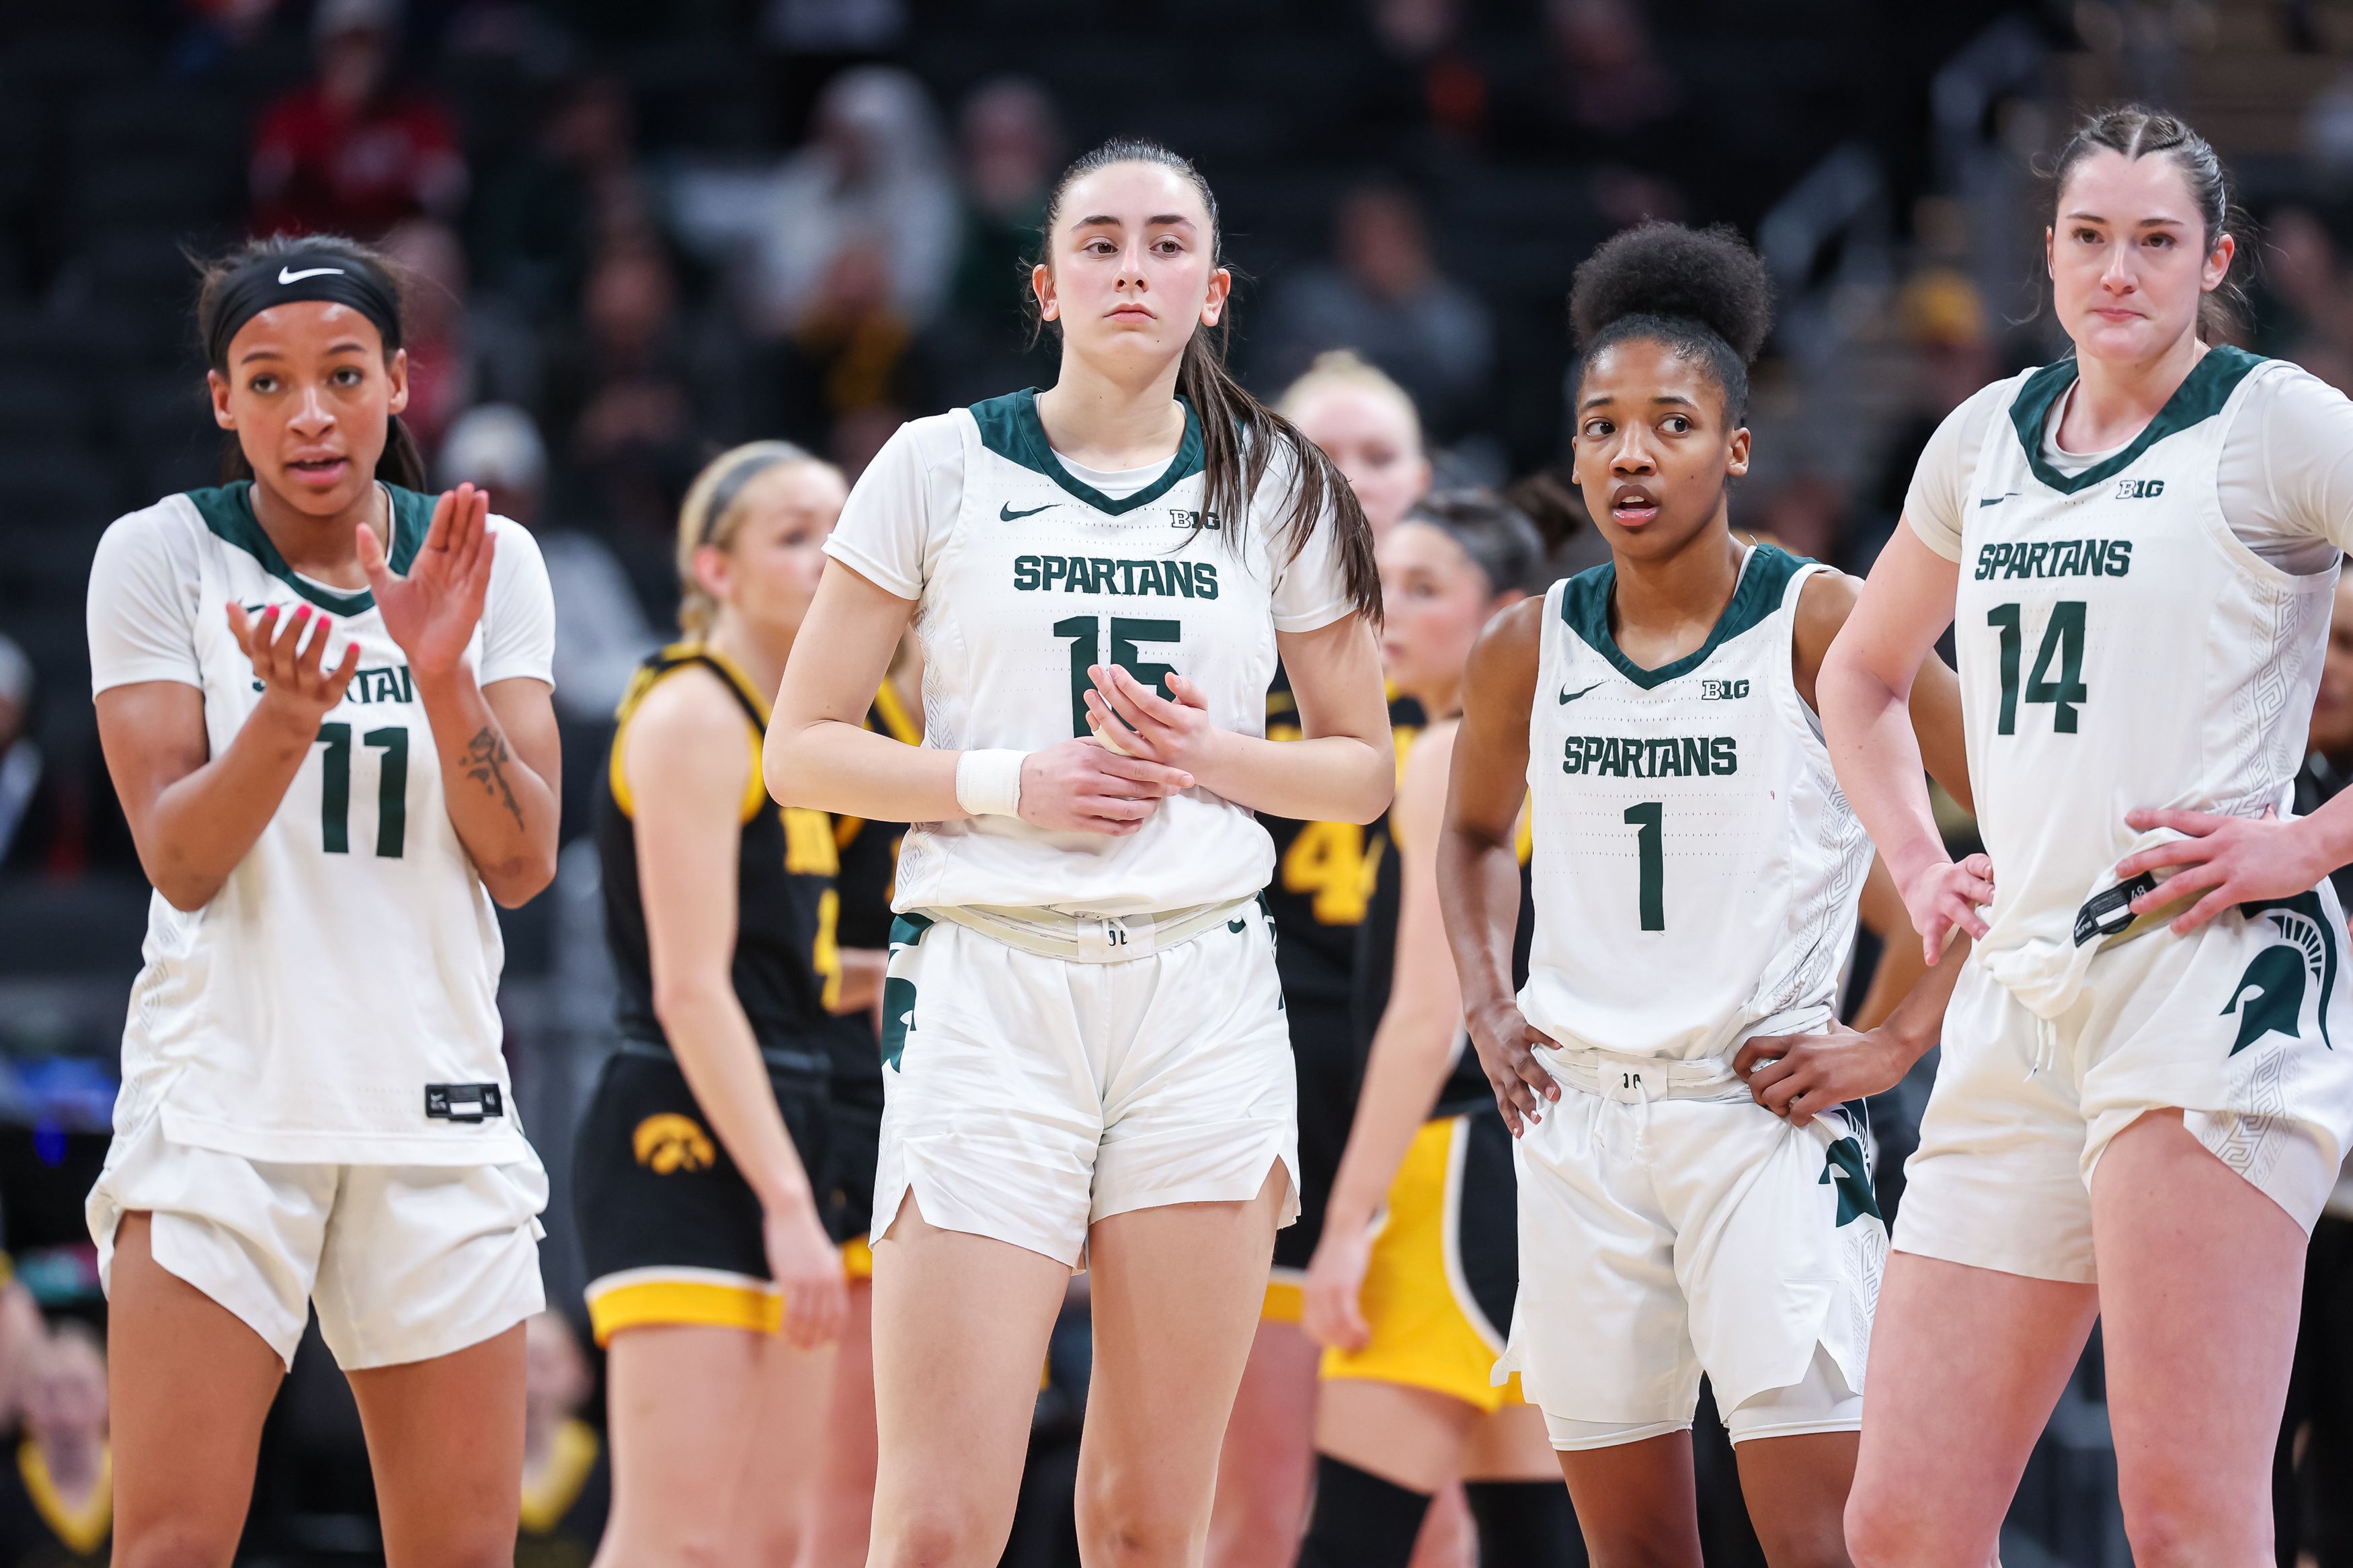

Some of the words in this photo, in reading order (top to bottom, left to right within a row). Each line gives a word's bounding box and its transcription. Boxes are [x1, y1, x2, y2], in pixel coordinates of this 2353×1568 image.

[1014, 554, 1219, 600] SPARTANS
[1975, 539, 2132, 580] SPARTANS
[1053, 616, 1181, 739] 15
[1987, 601, 2087, 735] 14
[315, 722, 408, 858] 11
[1562, 736, 1737, 778] SPARTANS
[1624, 802, 1665, 931] 1
